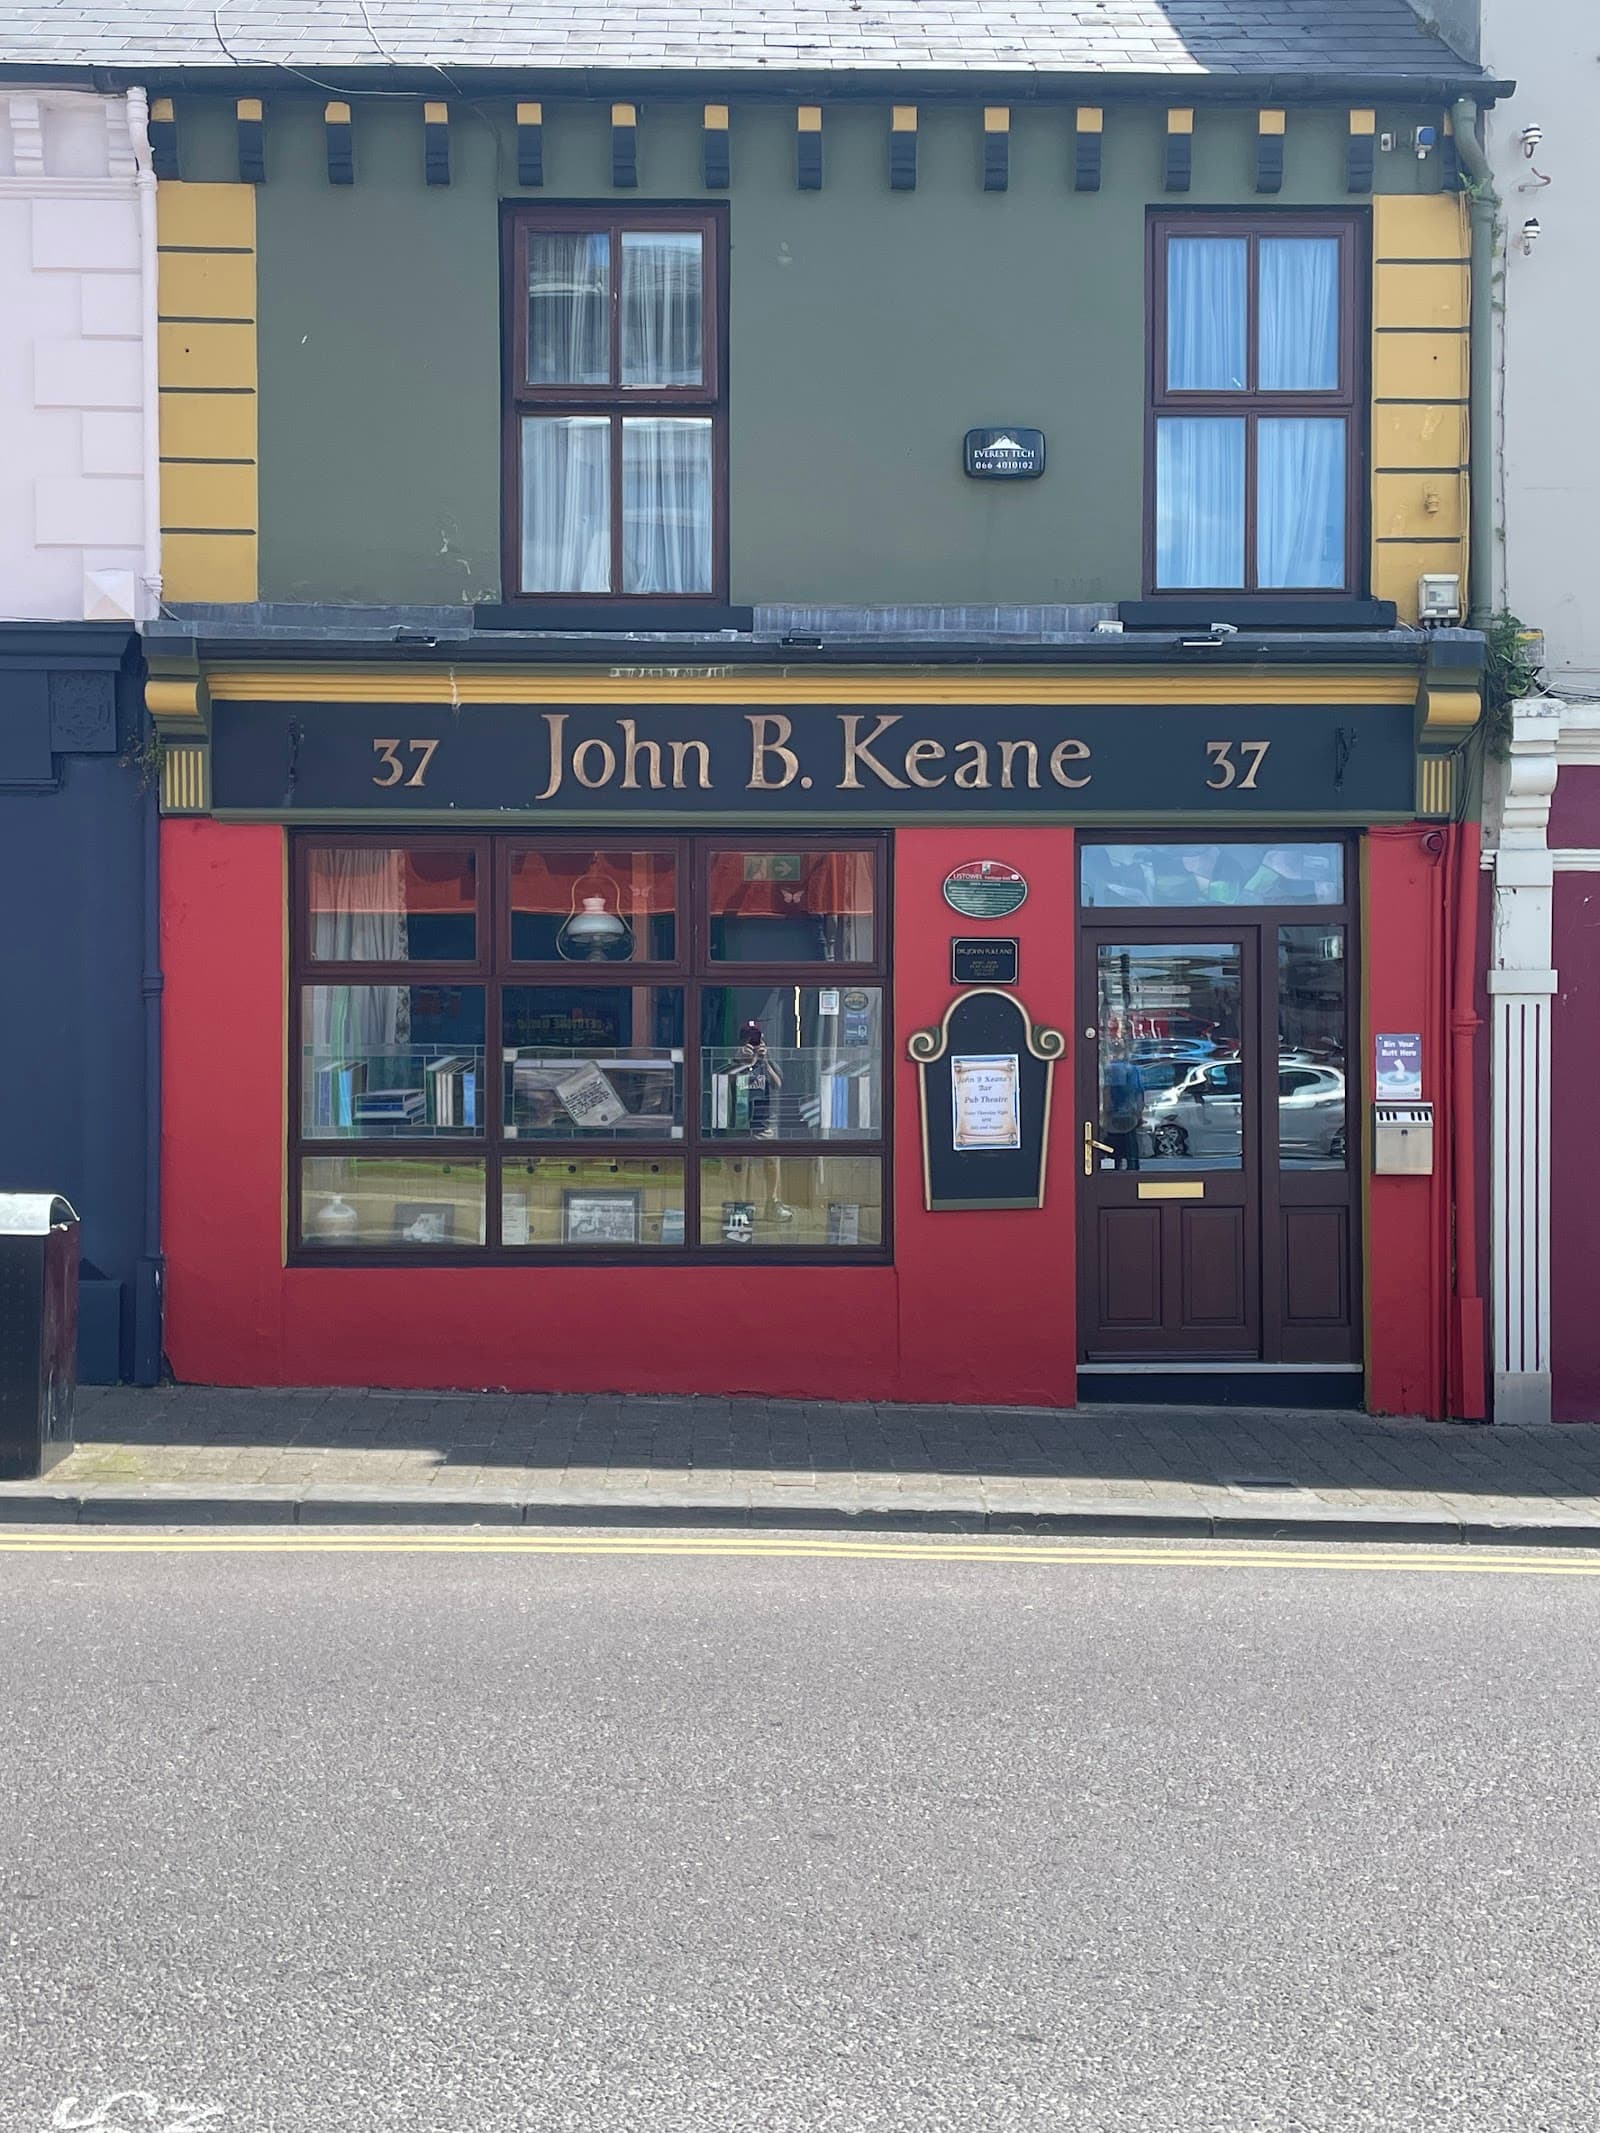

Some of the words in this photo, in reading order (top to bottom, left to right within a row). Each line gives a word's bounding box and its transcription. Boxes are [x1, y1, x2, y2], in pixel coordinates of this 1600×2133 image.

[974, 450, 1009, 458] EVEREST
[1012, 450, 1034, 458] TECH
[975, 461, 993, 469] 066
[996, 461, 1033, 469] 4010102
[372, 738, 440, 787] 37
[535, 713, 714, 800] John
[744, 714, 813, 790] B.
[835, 714, 1093, 790] Keane
[1205, 740, 1272, 789] 37
[964, 1095, 979, 1104] Pub
[980, 1095, 1009, 1103] Theatre
